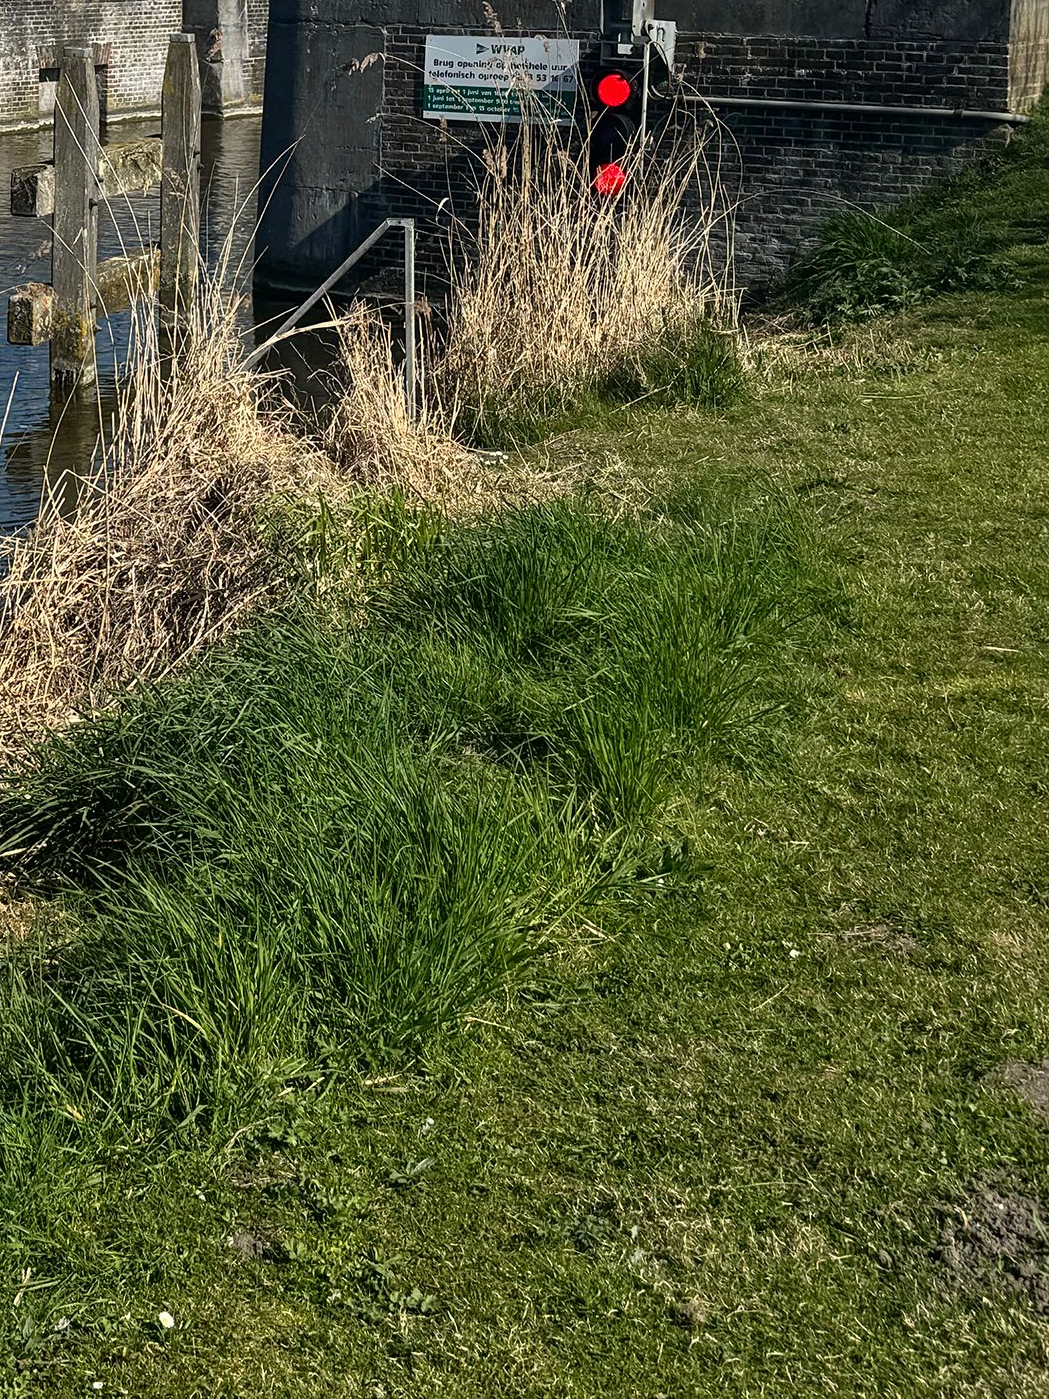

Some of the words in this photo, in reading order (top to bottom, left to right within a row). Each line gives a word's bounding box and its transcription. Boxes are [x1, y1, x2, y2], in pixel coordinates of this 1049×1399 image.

[491, 44, 525, 55] WVAP
[433, 59, 454, 68] Brug
[529, 62, 548, 71] hele
[428, 70, 475, 79] telefonisch
[478, 73, 509, 82] oproep
[536, 74, 547, 82] 53
[563, 75, 573, 83] 67
